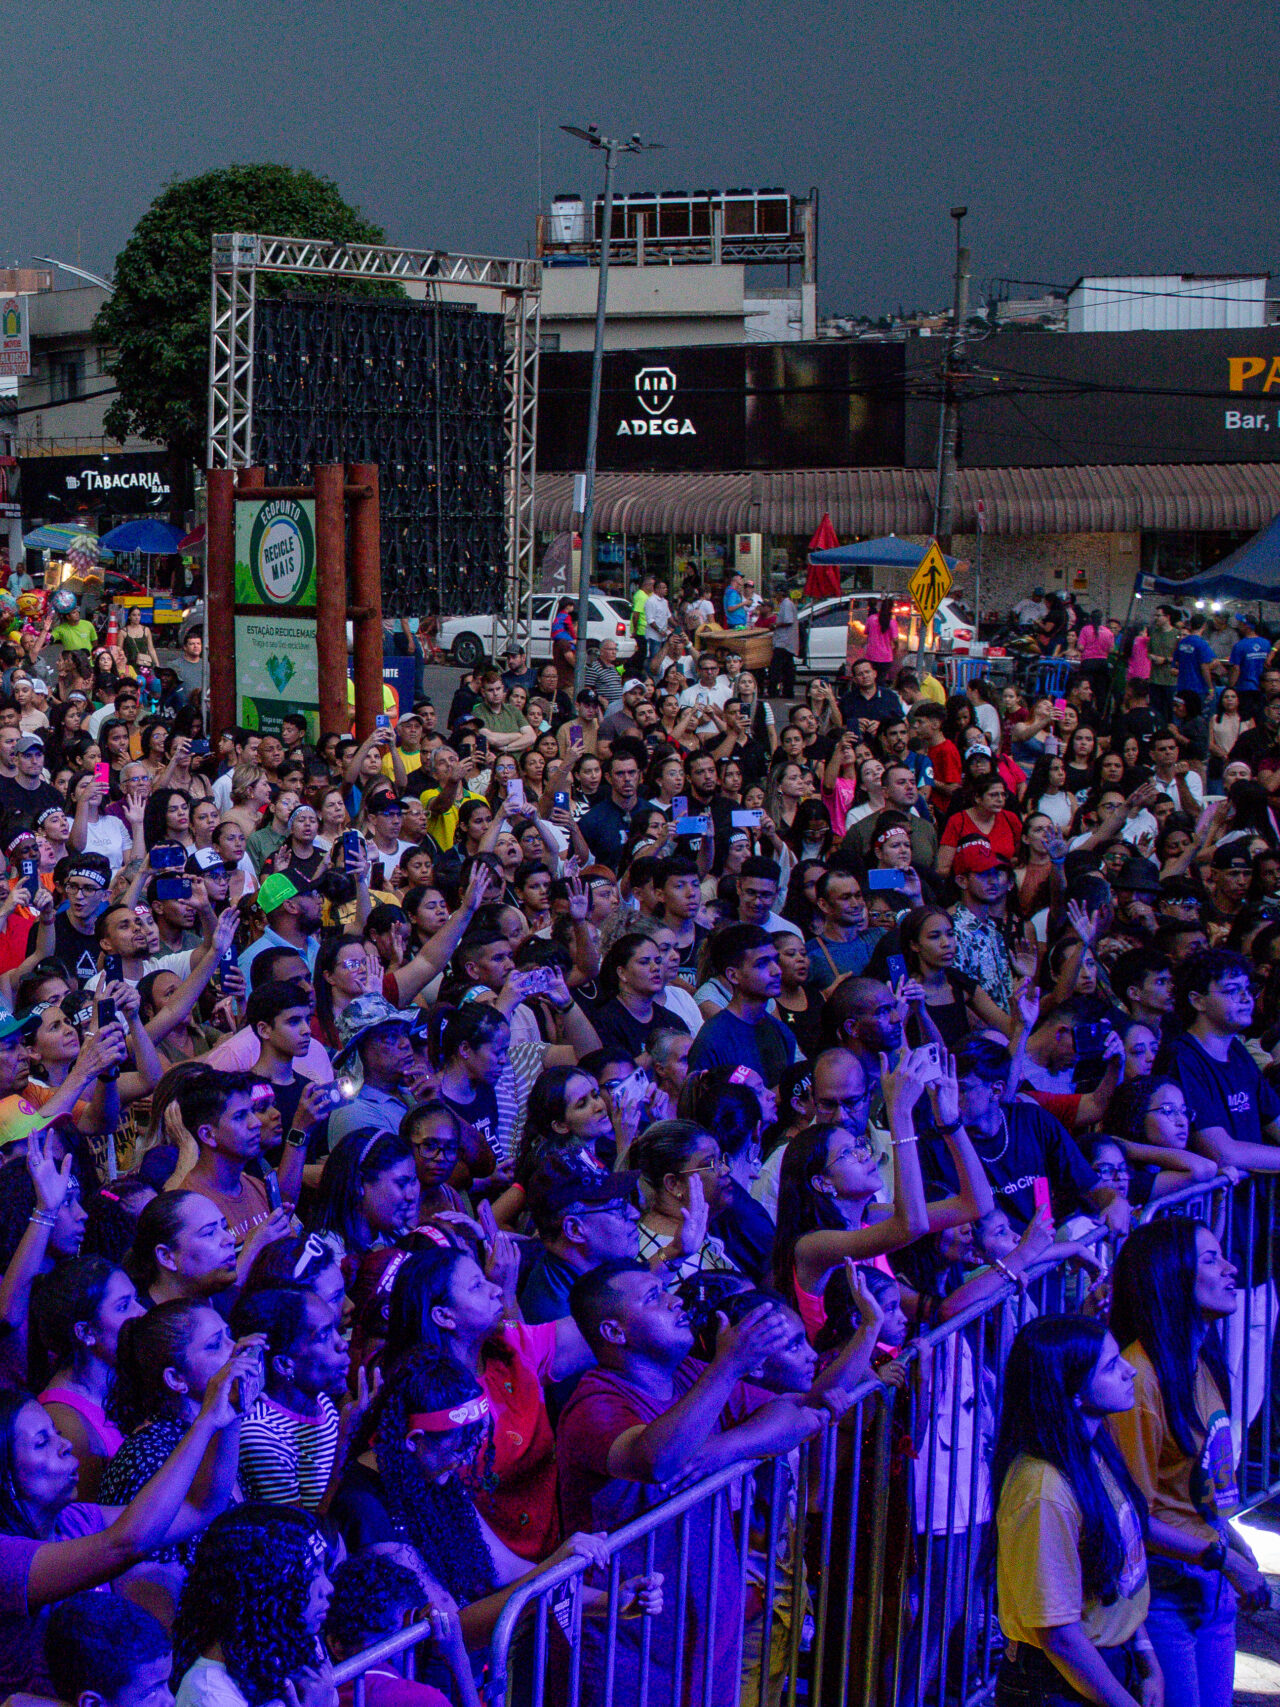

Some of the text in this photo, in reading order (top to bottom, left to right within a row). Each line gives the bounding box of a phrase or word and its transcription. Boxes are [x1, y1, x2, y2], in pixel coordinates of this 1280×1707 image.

[616, 419, 697, 436] ADEGA
[1225, 411, 1270, 432] Bar,
[81, 470, 161, 490] TABACARIA
[151, 485, 170, 493] BAR
[260, 500, 301, 525] ECOPONTO
[264, 536, 295, 564] RECICLE
[271, 557, 295, 581] MAIS
[247, 625, 275, 638] ESTAÇÃO
